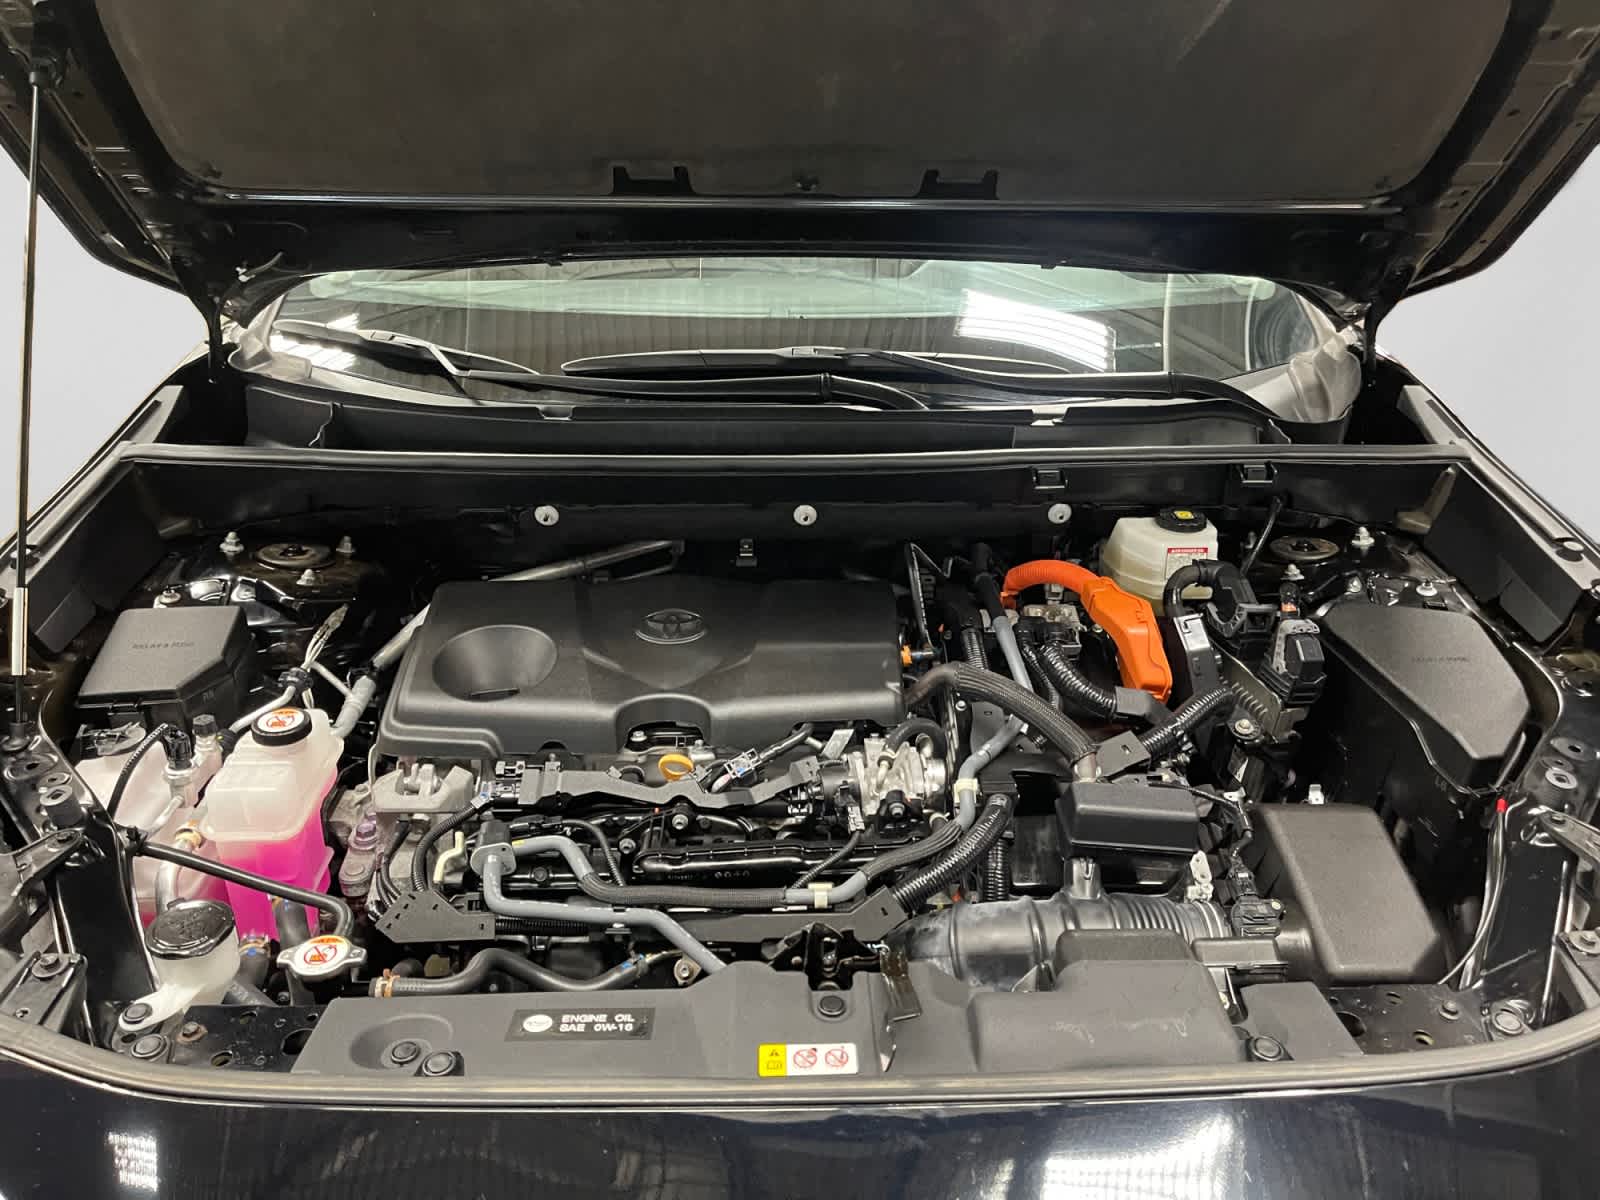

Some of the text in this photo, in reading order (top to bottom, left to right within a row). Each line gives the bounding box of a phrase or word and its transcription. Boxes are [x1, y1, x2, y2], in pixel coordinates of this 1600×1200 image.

[561, 1014, 608, 1023] ENGINE
[614, 1014, 635, 1023] OIL
[560, 1023, 586, 1032] SAE
